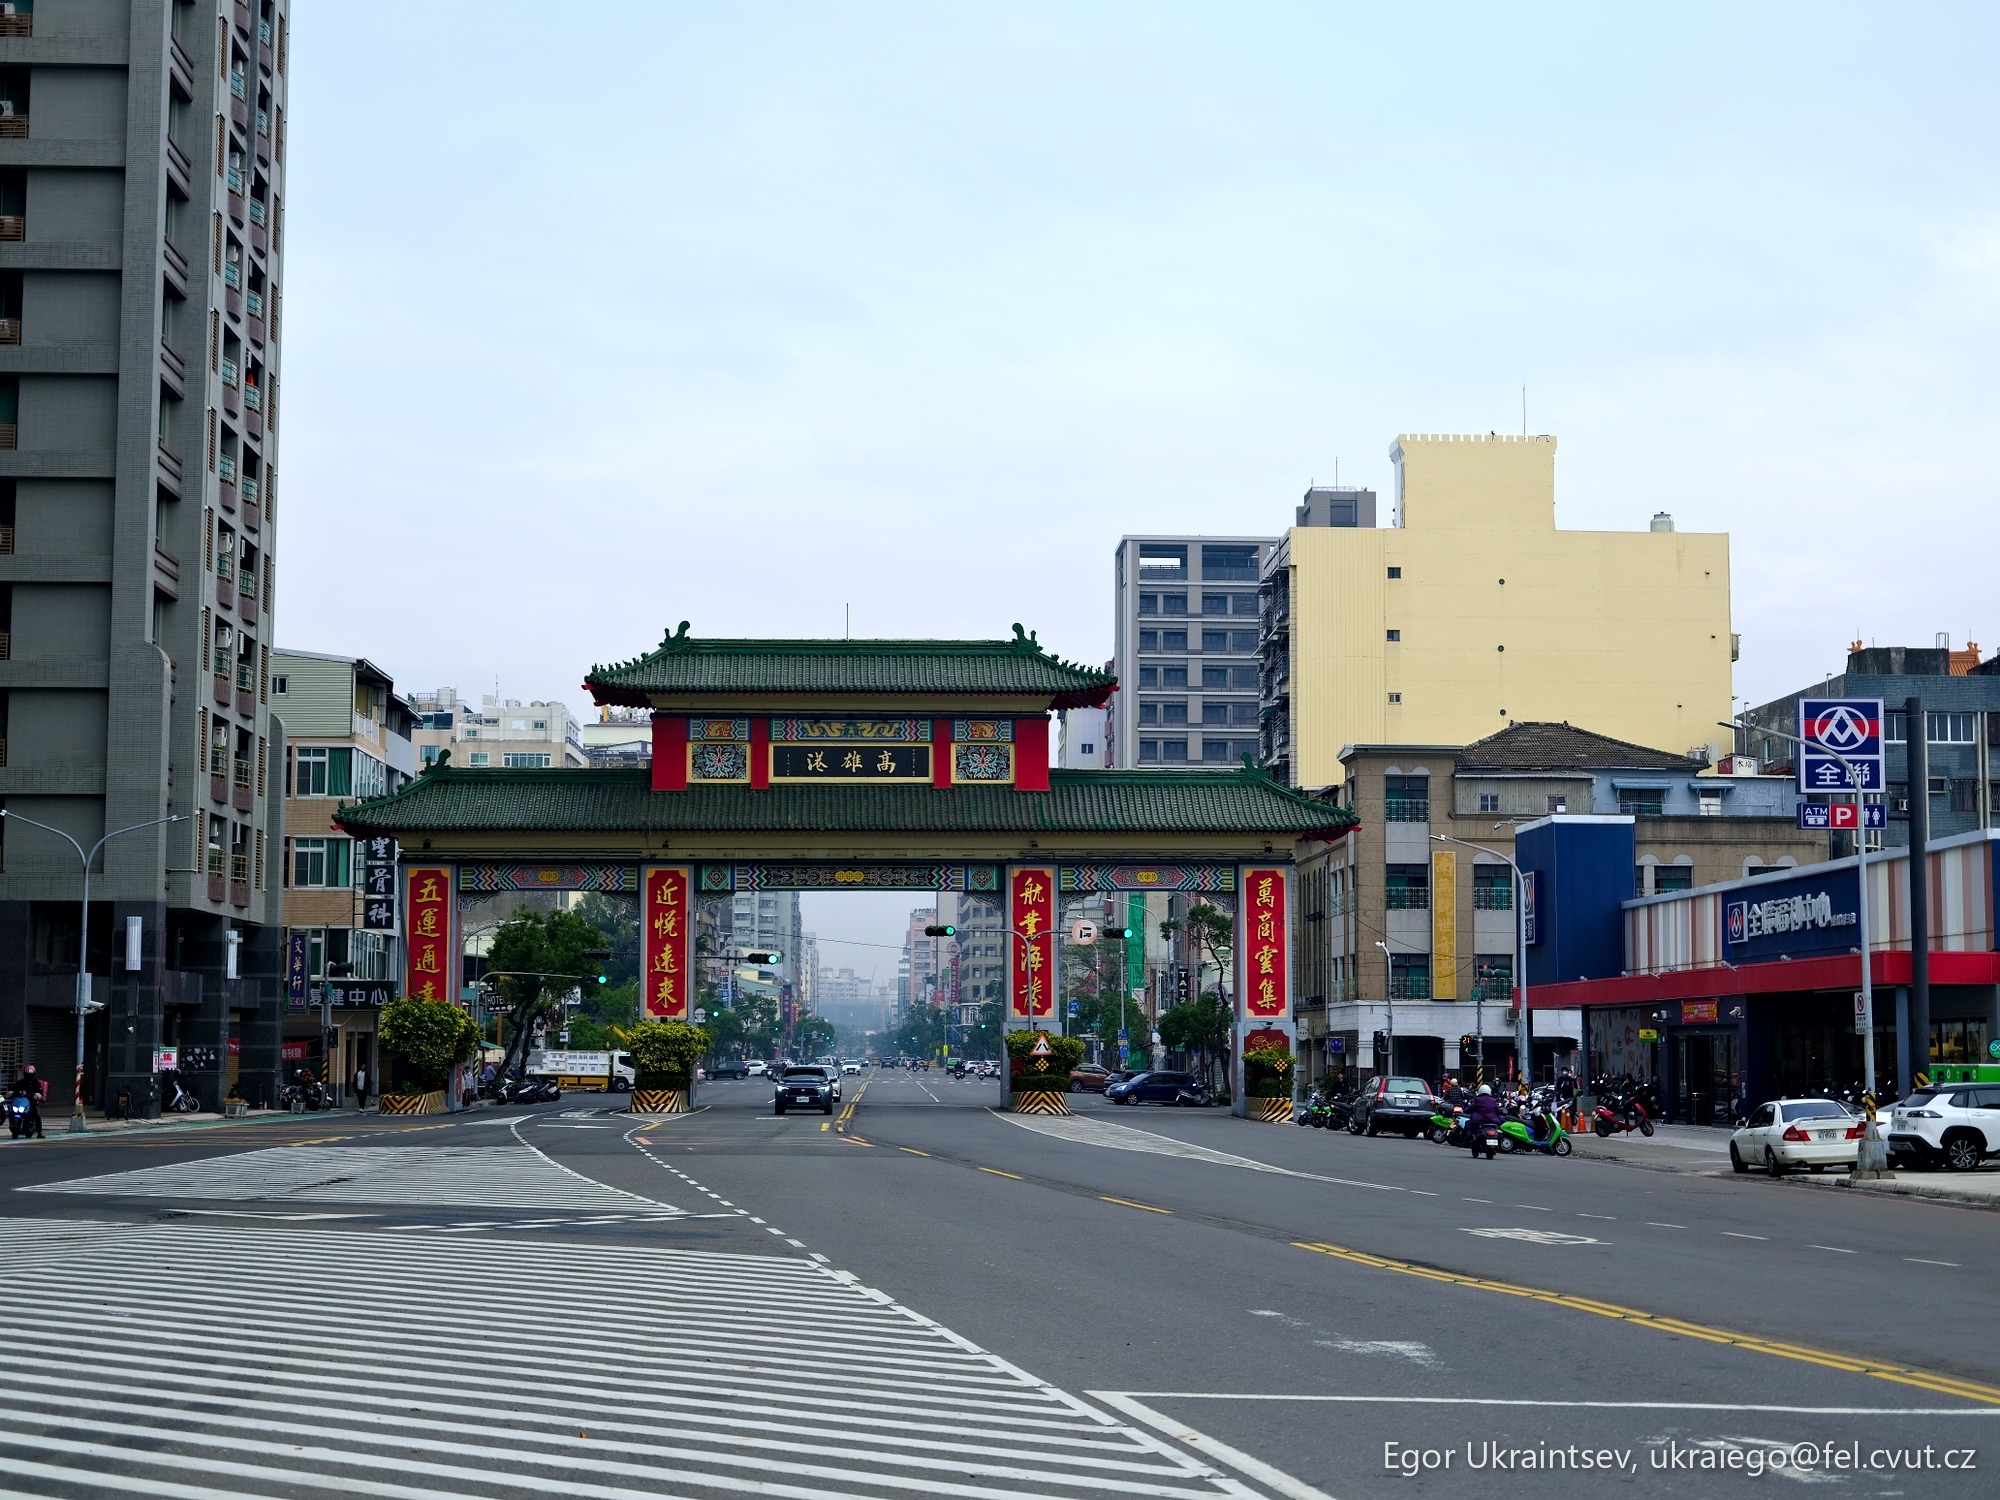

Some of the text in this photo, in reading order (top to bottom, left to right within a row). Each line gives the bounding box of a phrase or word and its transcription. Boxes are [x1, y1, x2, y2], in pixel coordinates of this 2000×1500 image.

[806, 749, 897, 774] 高雄港
[1815, 762, 1871, 786] 全聯
[1804, 807, 1828, 815] ATM
[1835, 807, 1852, 825] P
[1253, 877, 1280, 1010] 萬商雲集
[1462, 1036, 1471, 1044] 21
